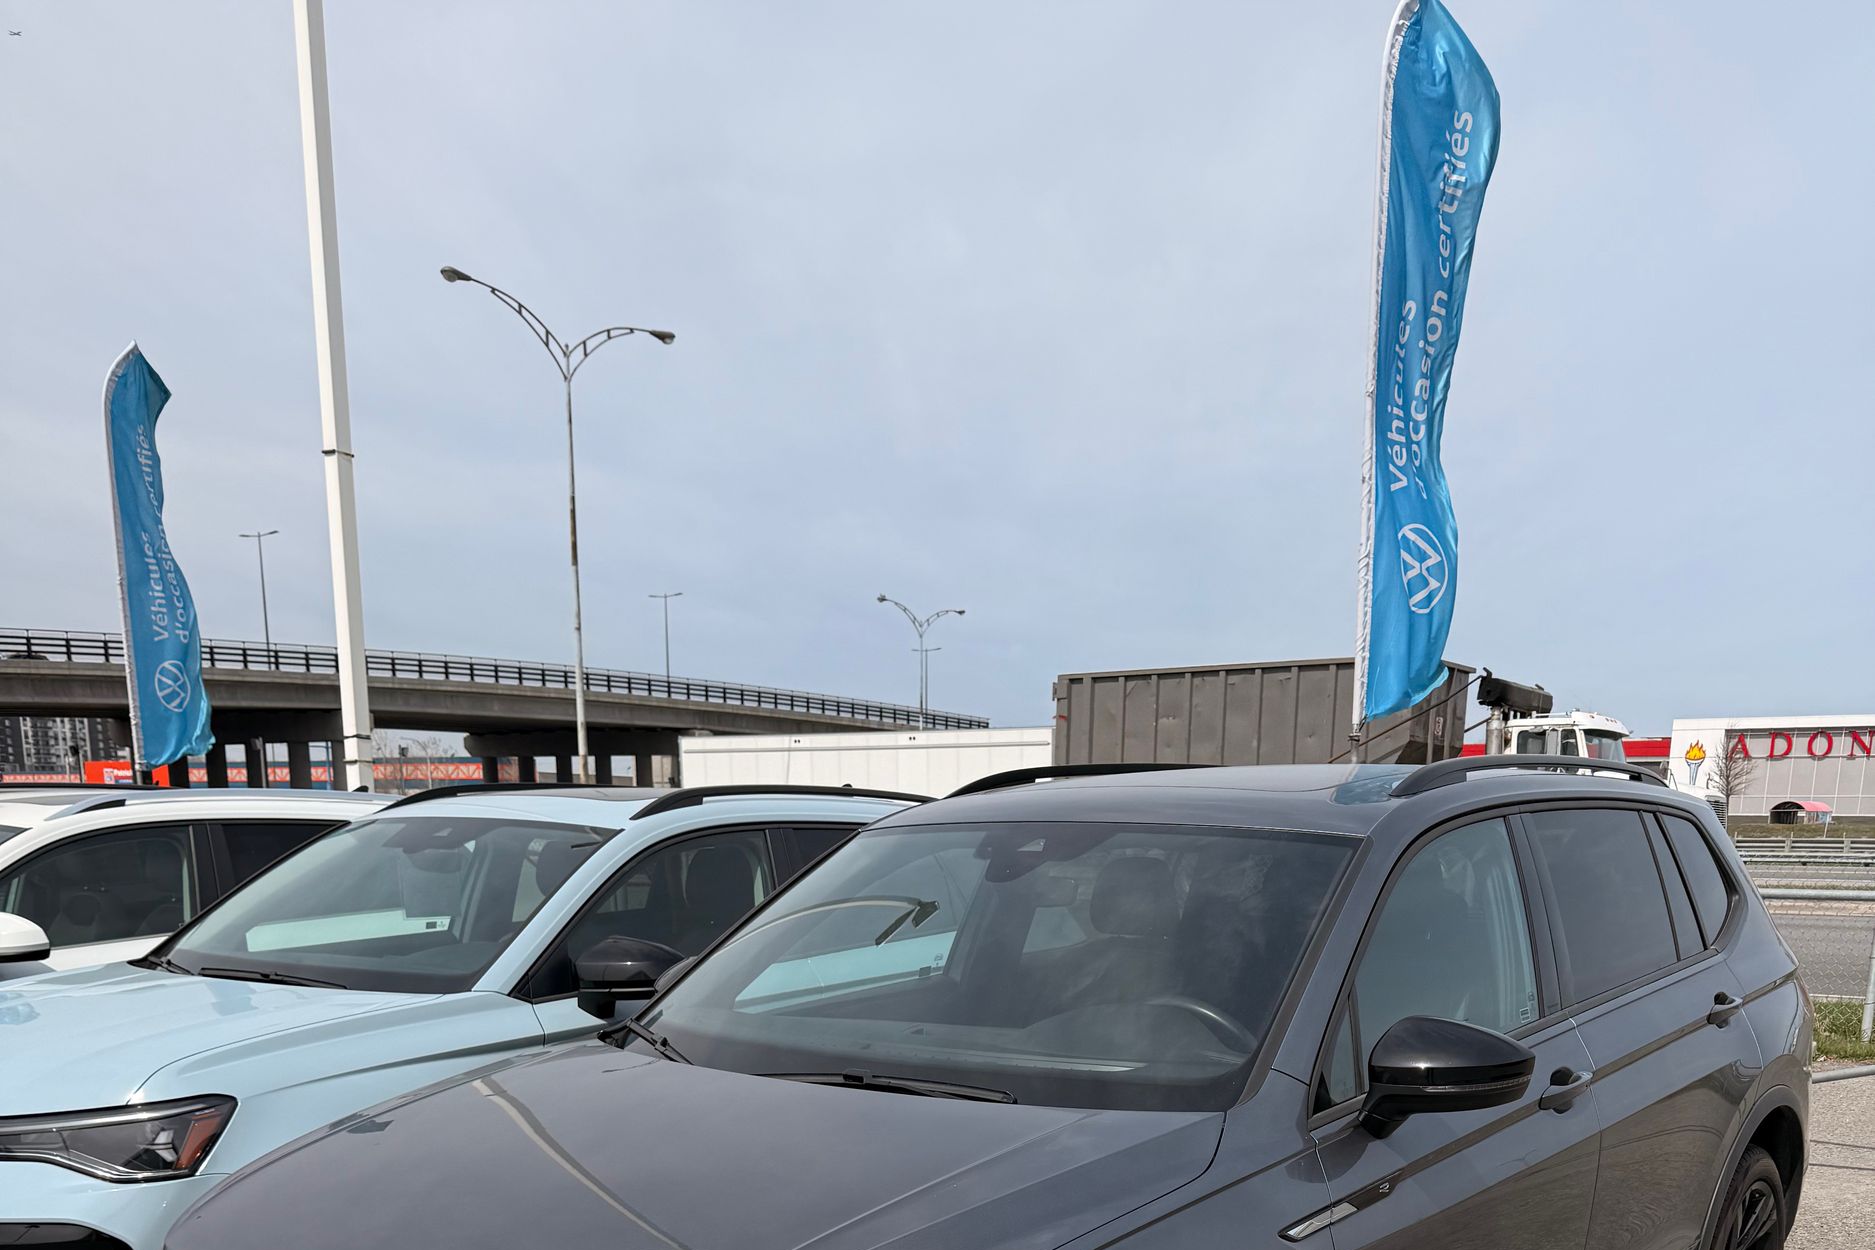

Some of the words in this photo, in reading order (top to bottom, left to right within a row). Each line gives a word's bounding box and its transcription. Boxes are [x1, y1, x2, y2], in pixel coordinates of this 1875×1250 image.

[1409, 290, 1448, 499] d'occasion
[1437, 110, 1473, 278] certifiés
[1387, 300, 1417, 491] Véhicules
[136, 424, 162, 518] certifiés
[141, 531, 169, 642] Véhicules
[158, 524, 189, 643] d'occasion
[1728, 730, 1875, 760] ADON
